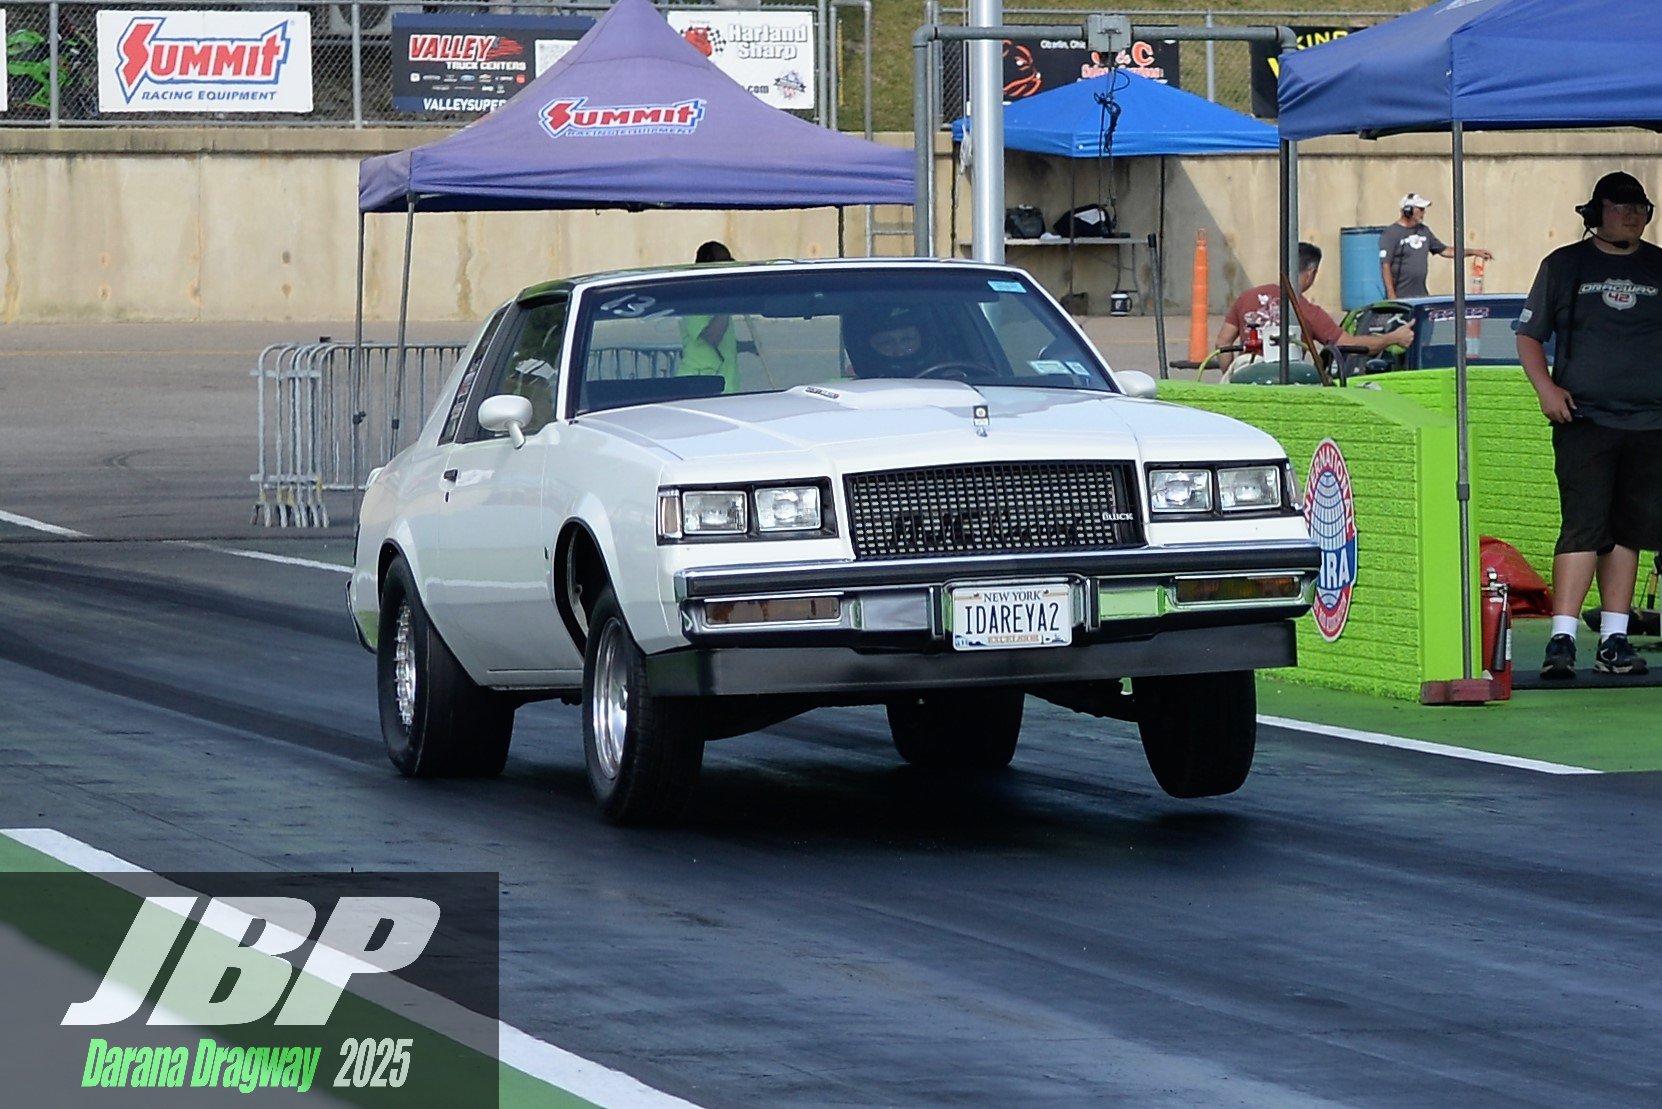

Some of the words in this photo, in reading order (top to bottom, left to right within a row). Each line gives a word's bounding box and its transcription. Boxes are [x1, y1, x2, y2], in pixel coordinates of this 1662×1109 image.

[728, 24, 807, 42] Harland
[409, 34, 496, 61] VALLEY
[738, 42, 798, 60] Sharp
[1131, 41, 1155, 66] C
[446, 62, 479, 70] TRUCK
[480, 62, 526, 71] CENTERS
[141, 91, 193, 100] RACING
[199, 90, 277, 101] EQUIPMENT
[1608, 293, 1630, 302] 42
[1102, 512, 1134, 521] BUICK
[984, 592, 1010, 602] NEW
[1012, 590, 1041, 601] YORK
[965, 602, 1060, 635] IDAREYA2
